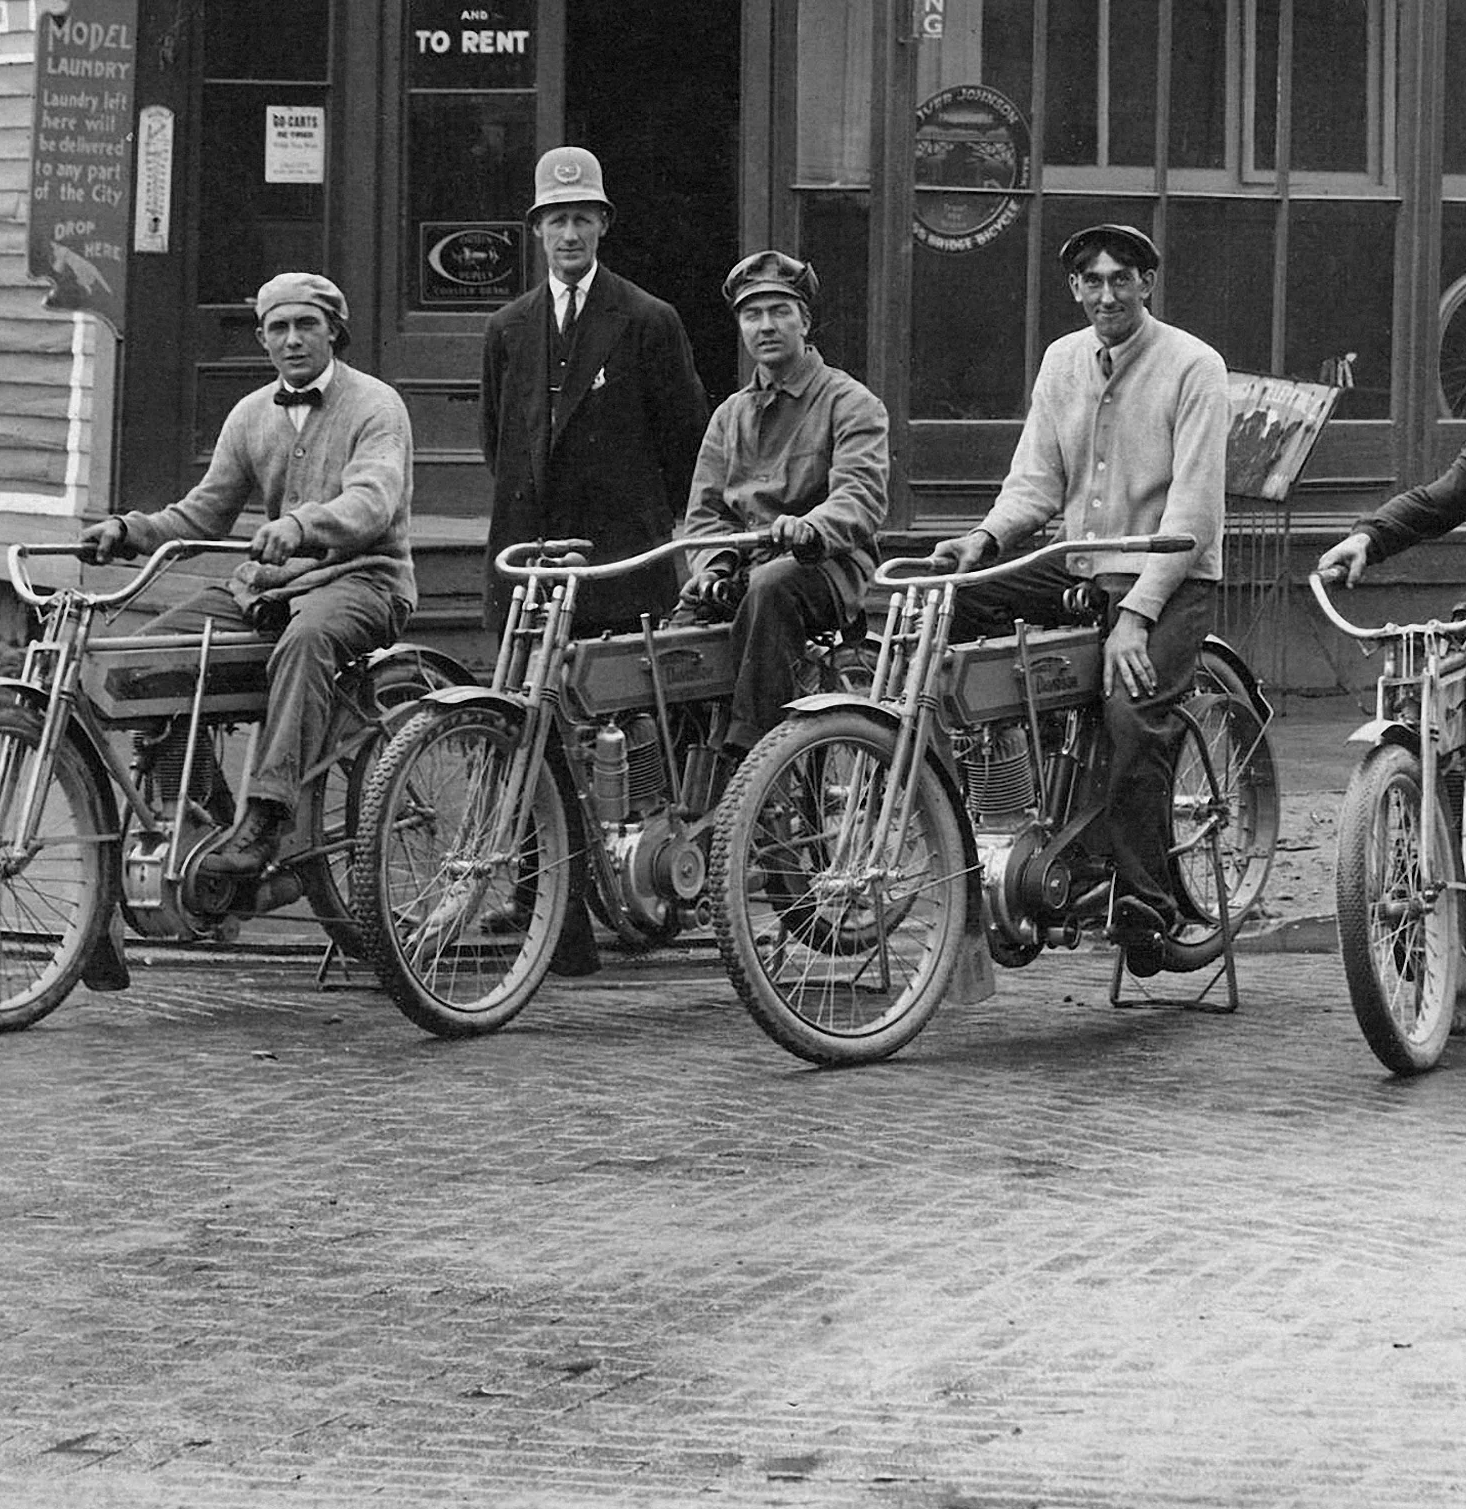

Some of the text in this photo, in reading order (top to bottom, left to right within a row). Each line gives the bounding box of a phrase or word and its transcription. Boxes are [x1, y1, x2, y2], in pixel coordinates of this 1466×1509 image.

[460, 10, 489, 21] AND
[47, 14, 133, 52] MODEL
[415, 29, 531, 54] TO RENT
[46, 56, 131, 80] LAUNDRY
[42, 88, 128, 114] Laundry left
[956, 87, 1019, 124] JOHNSON
[41, 109, 116, 134] here will
[39, 132, 125, 157] be delivered
[34, 158, 122, 184] to any part
[33, 180, 124, 208] of the City
[54, 219, 96, 241] DROP
[974, 198, 1021, 246] BICYCLE
[84, 242, 122, 261] HERE
